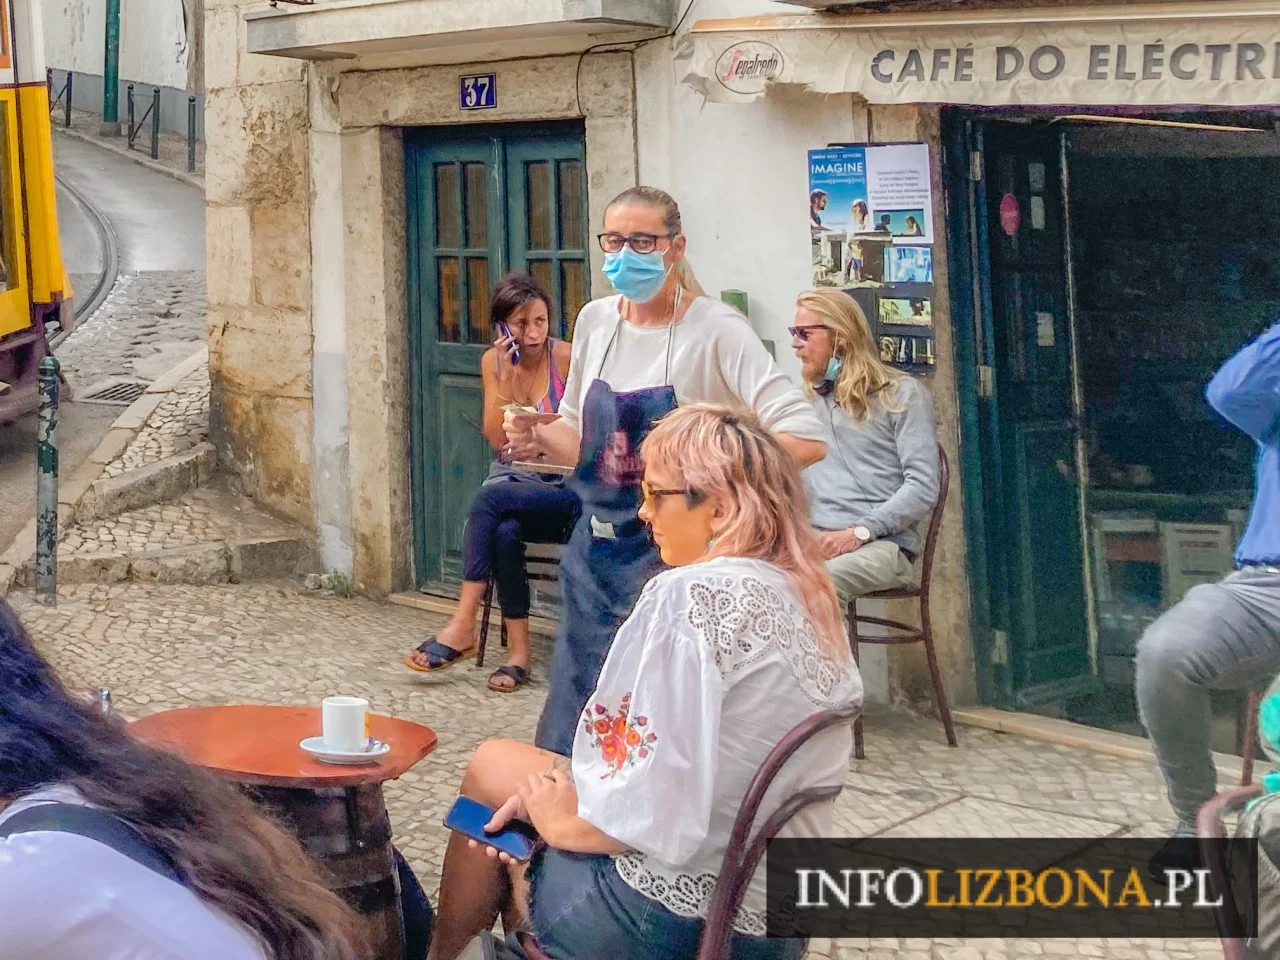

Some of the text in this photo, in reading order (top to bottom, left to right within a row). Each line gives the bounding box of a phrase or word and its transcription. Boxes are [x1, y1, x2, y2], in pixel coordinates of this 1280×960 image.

[870, 42, 975, 84] CAFÉ
[995, 44, 1066, 81] DO
[464, 77, 490, 107] 37
[811, 161, 864, 175] IMAGINE
